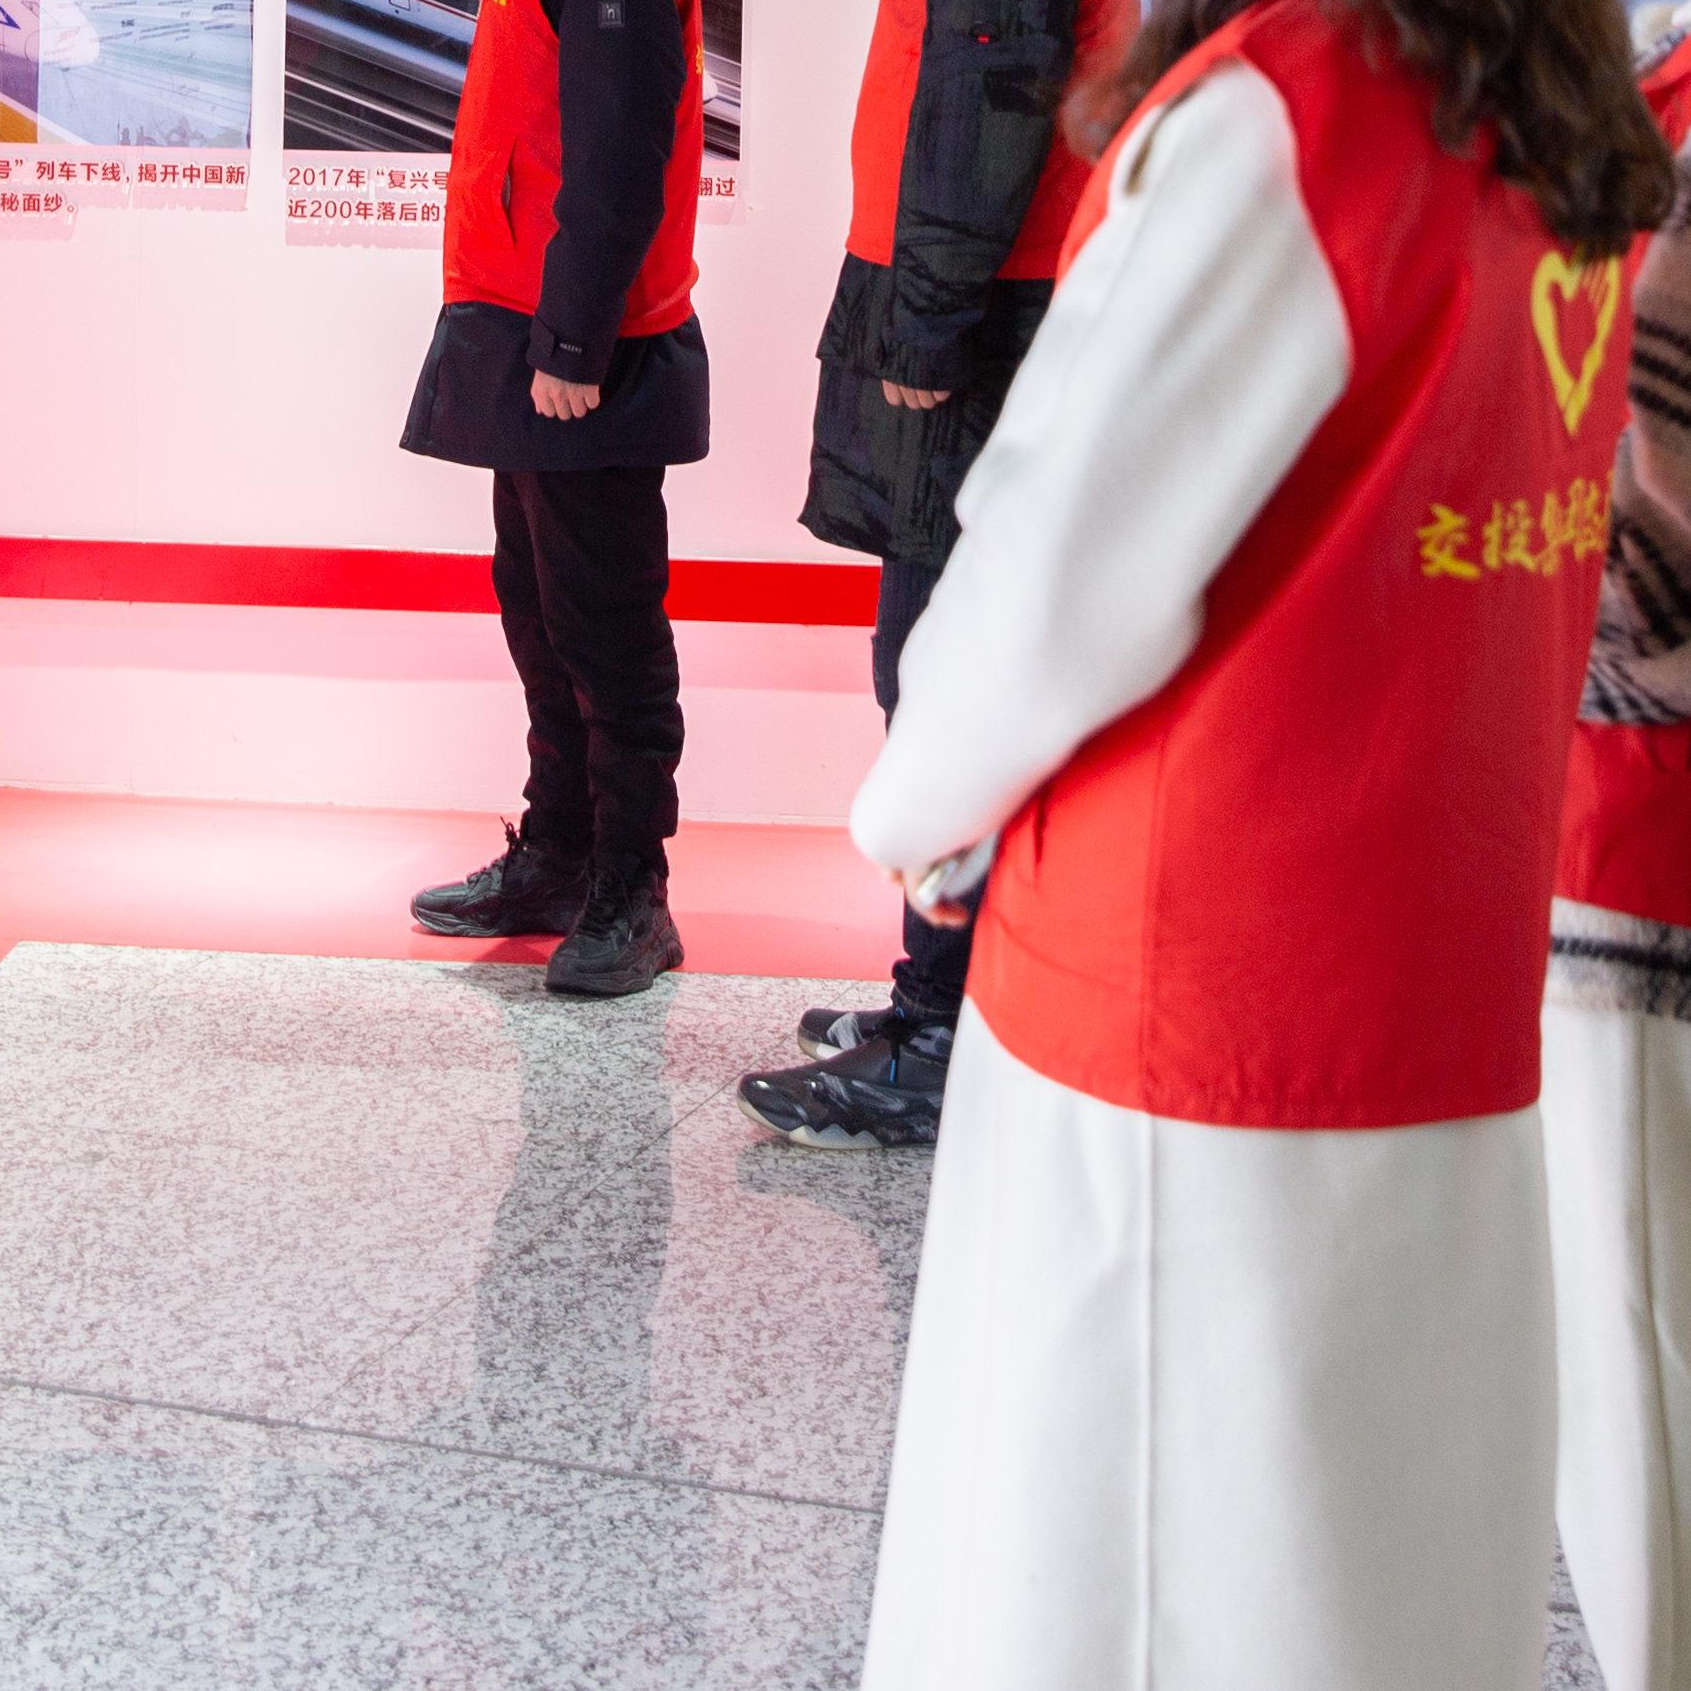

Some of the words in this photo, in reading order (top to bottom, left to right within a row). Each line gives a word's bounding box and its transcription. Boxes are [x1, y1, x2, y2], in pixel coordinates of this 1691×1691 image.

[287, 198, 448, 223] 近200年落后的
